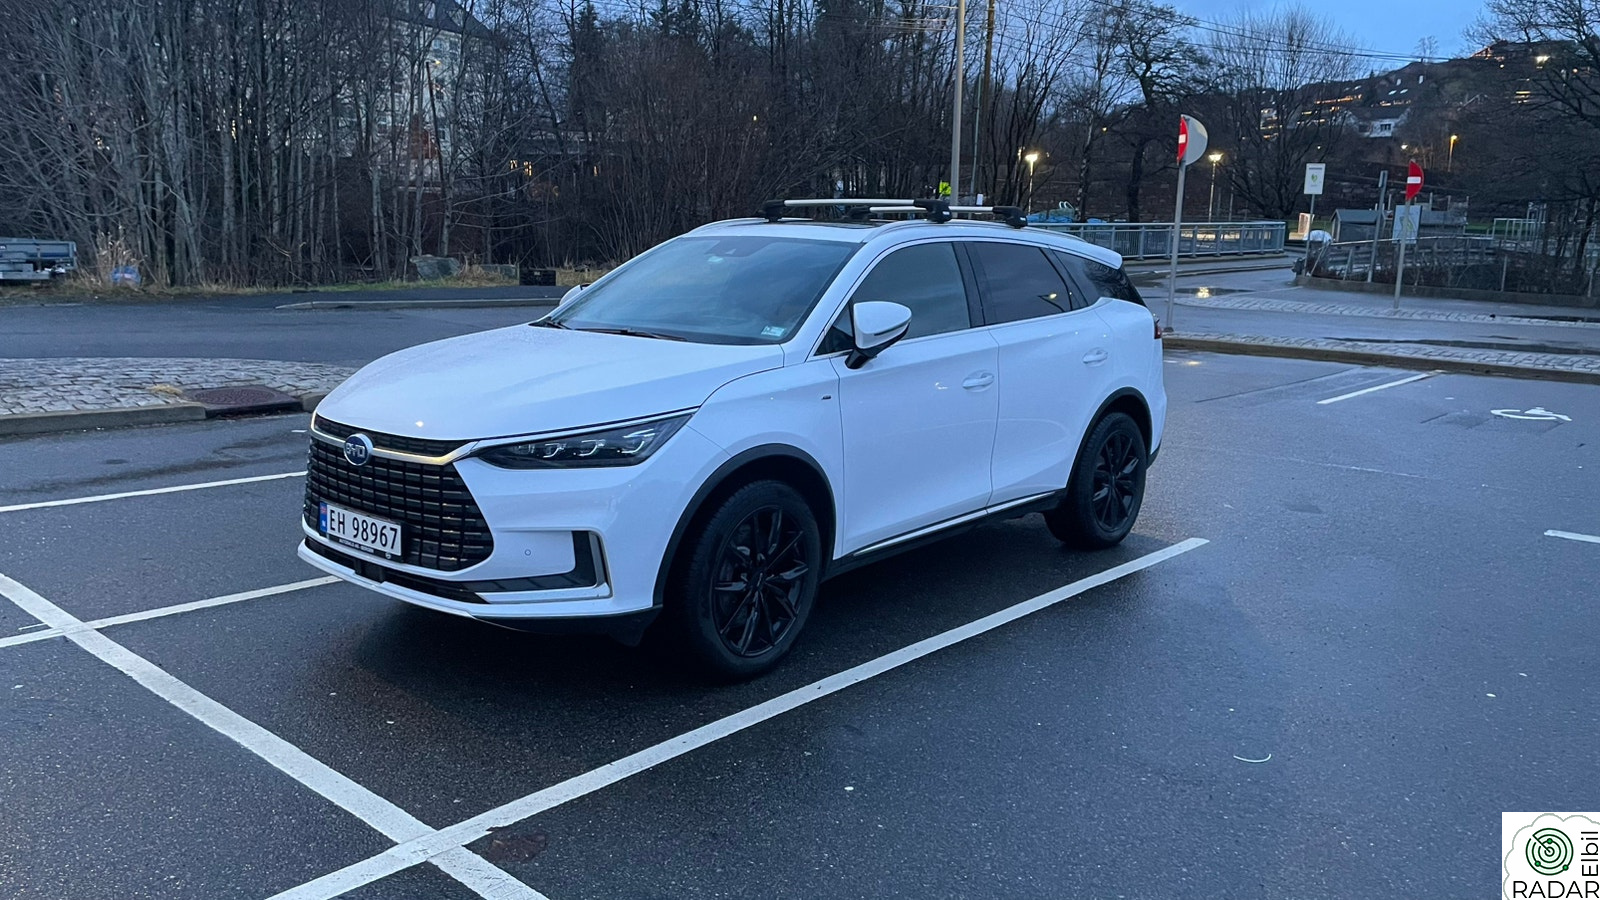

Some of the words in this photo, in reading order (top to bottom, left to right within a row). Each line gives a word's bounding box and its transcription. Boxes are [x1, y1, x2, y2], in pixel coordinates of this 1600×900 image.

[346, 442, 366, 458] BYD
[330, 509, 346, 535] EH
[352, 516, 398, 550] 98967
